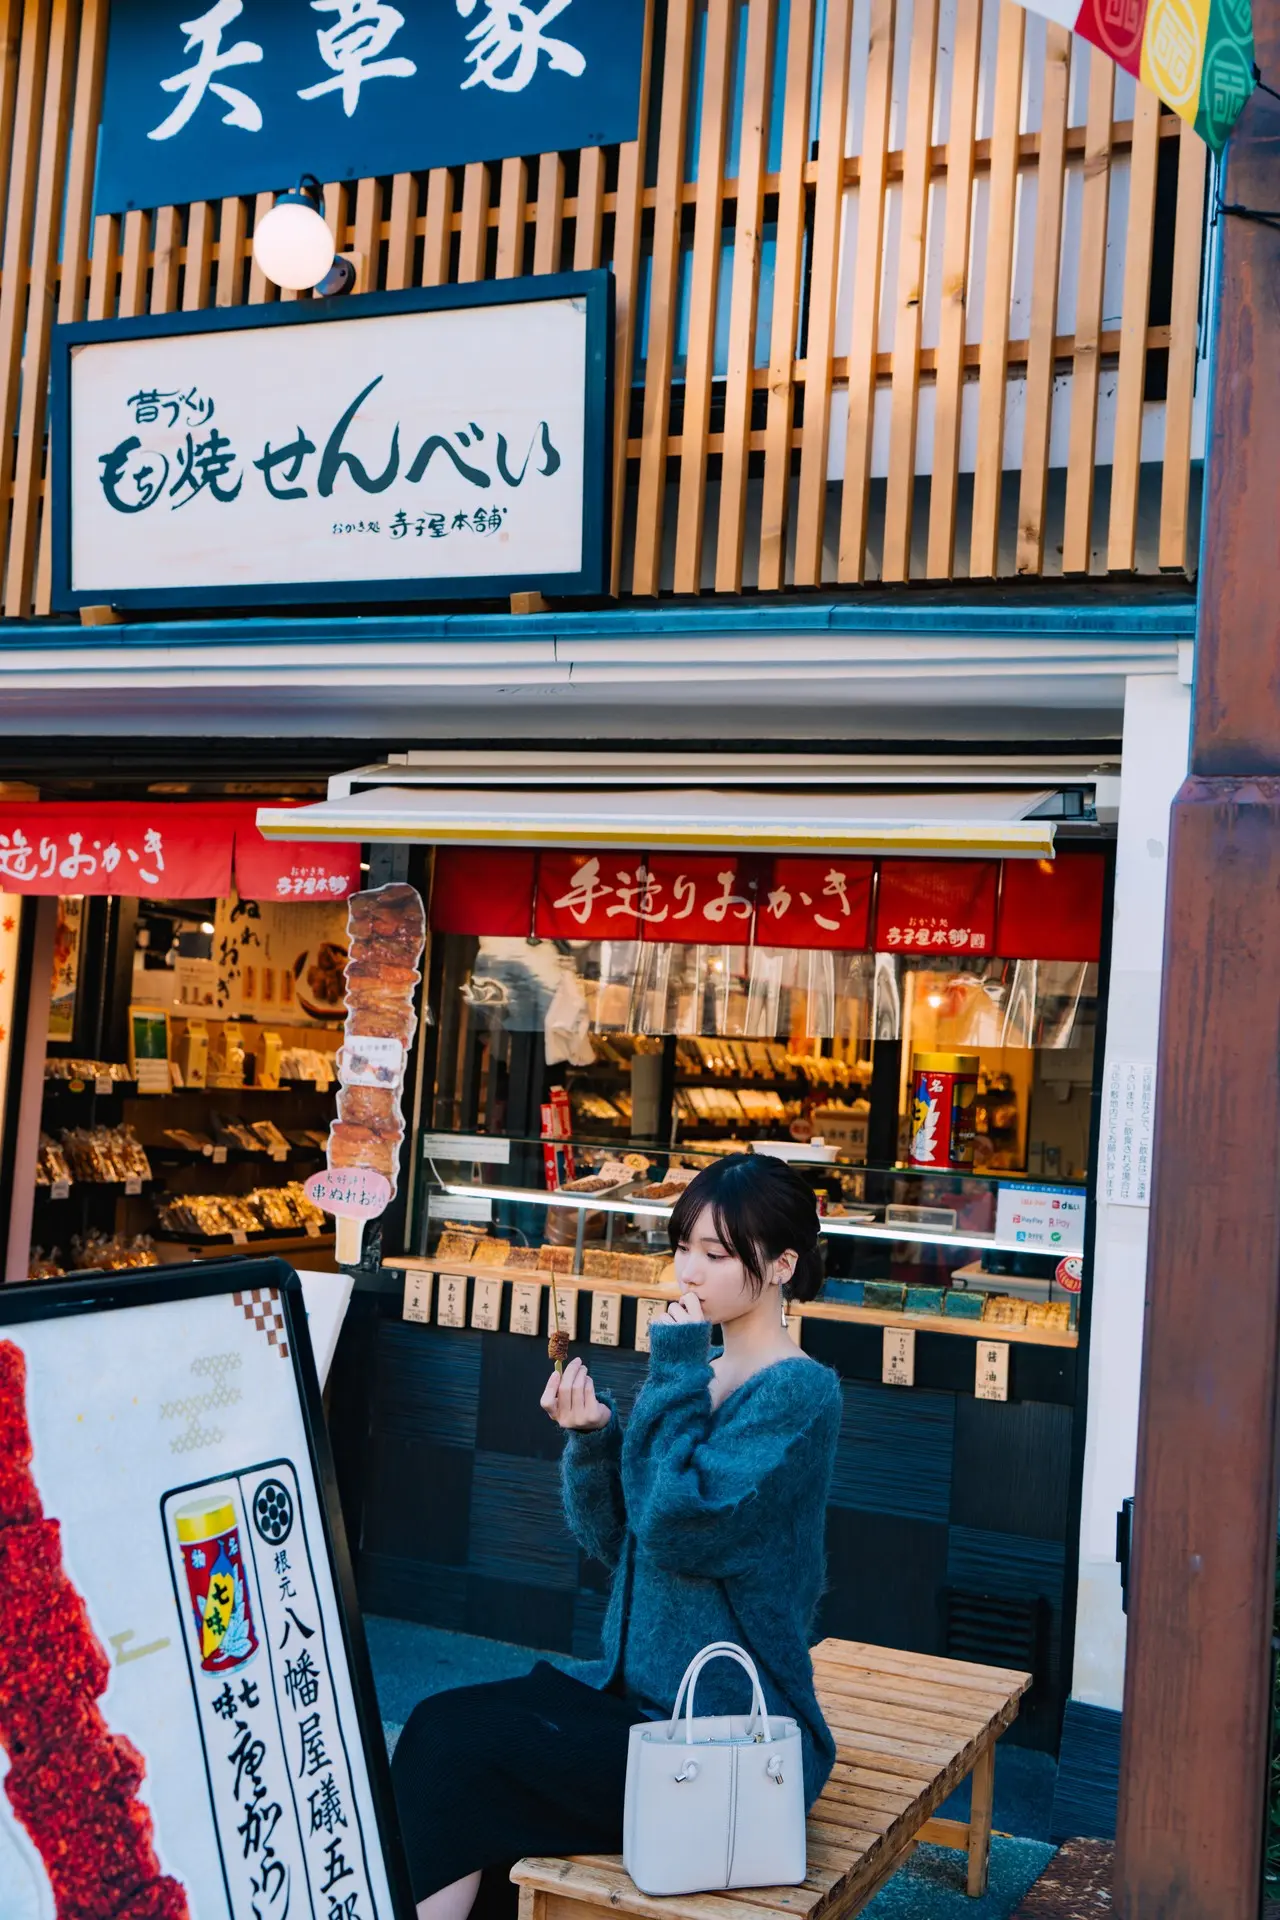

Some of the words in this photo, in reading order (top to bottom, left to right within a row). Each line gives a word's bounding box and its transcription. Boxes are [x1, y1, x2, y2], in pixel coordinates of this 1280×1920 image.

[127, 386, 215, 428] 昔づくり
[389, 504, 508, 540] 寺子屋本舗
[553, 857, 851, 931] 手造りおかき
[519, 1292, 531, 1315] 一味
[204, 1582, 230, 1638] 七味
